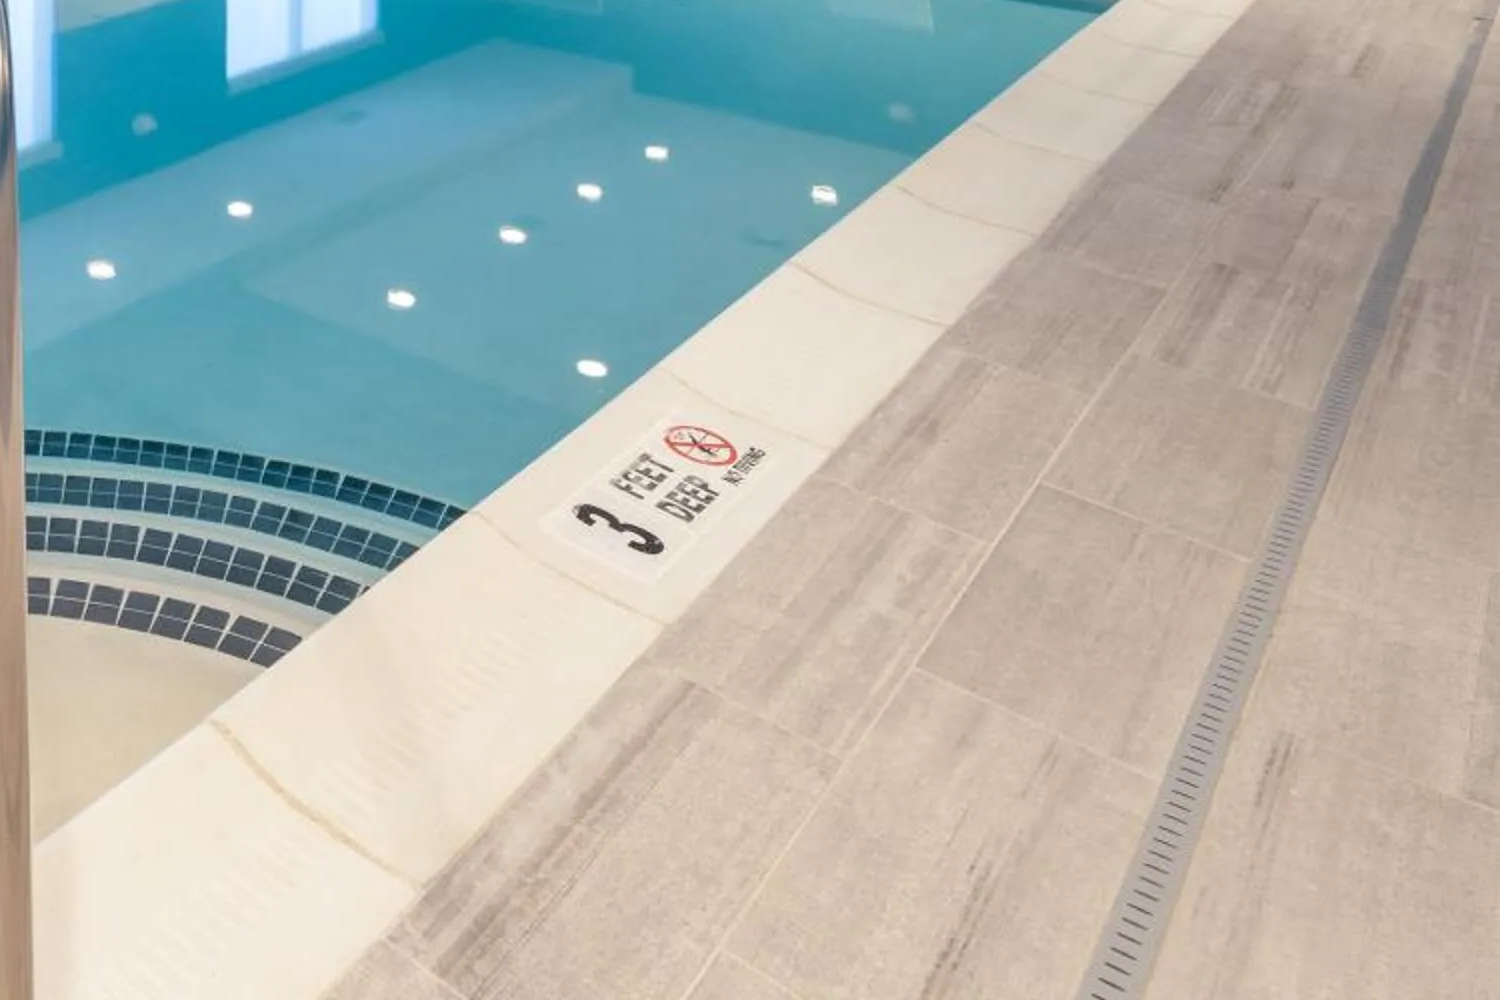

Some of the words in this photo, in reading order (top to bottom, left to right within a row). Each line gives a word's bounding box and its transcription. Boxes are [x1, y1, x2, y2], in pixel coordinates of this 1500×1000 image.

[609, 452, 674, 500] FEET
[656, 475, 719, 523] DEEP
[572, 503, 664, 555] 3
